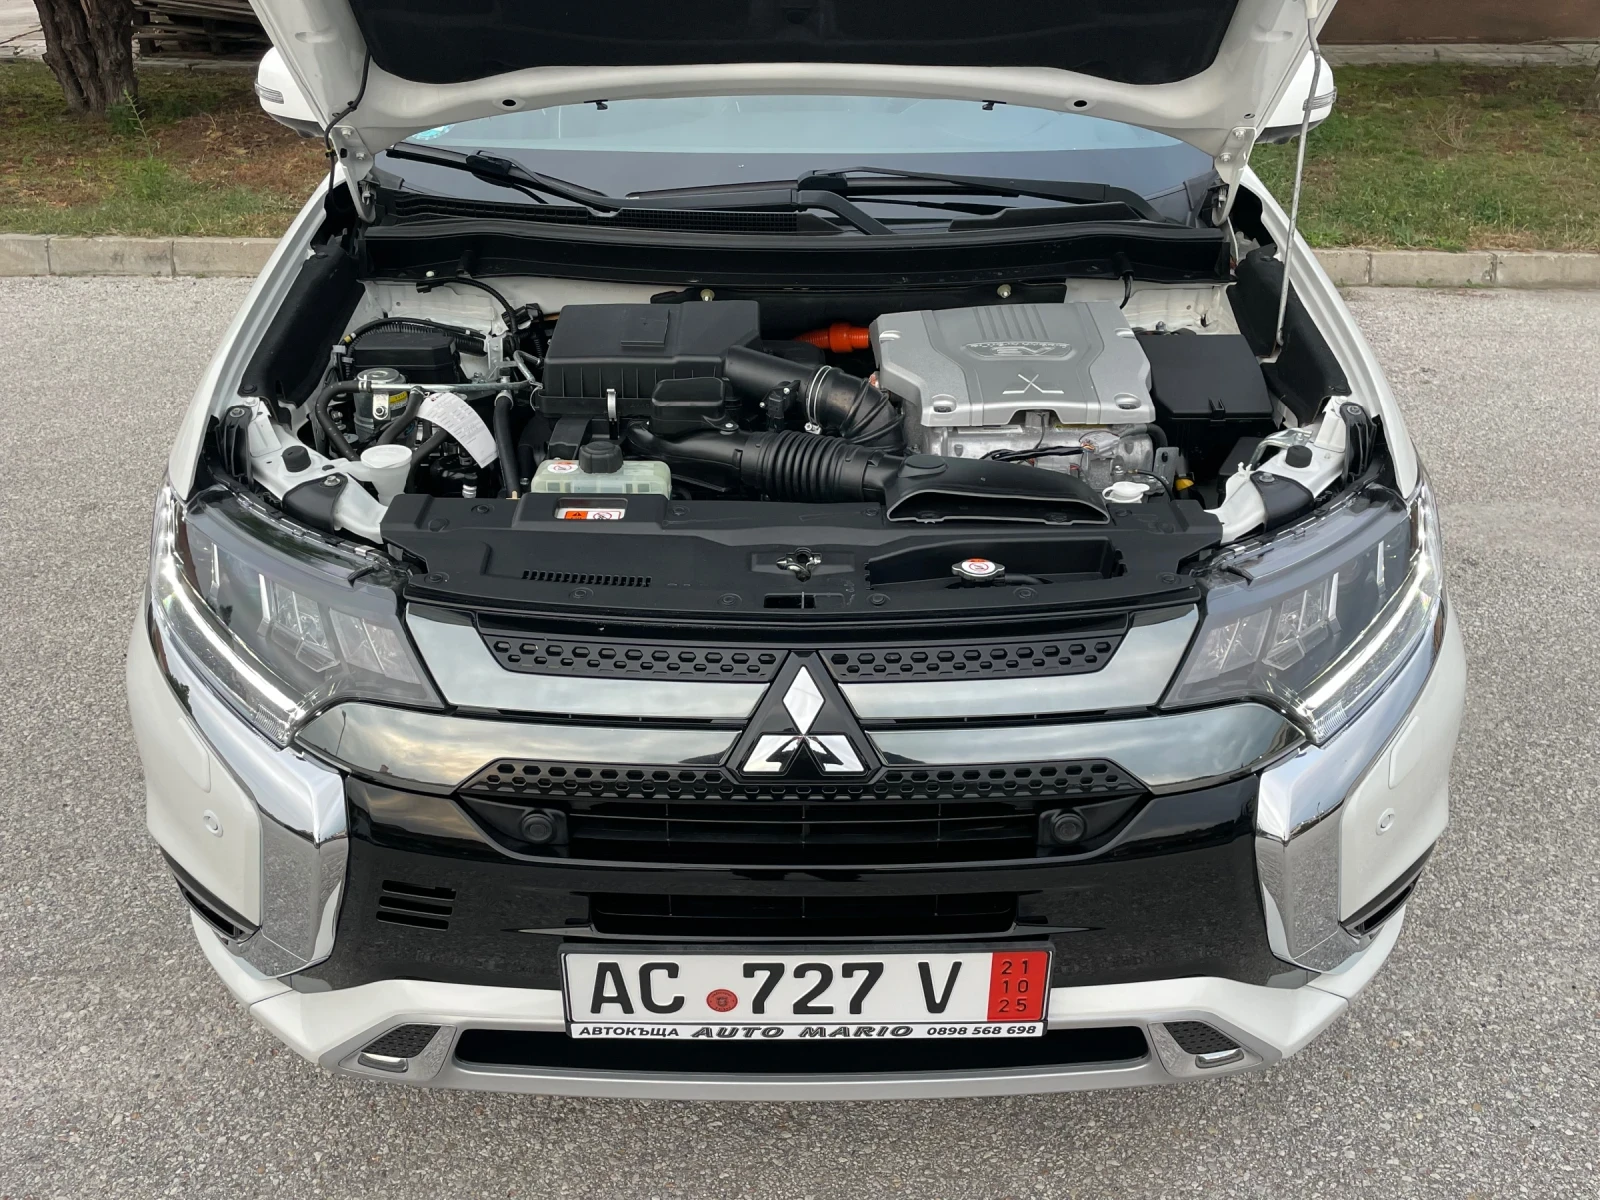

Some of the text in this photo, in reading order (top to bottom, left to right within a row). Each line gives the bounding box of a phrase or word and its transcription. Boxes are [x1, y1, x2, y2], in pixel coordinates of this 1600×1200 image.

[1001, 960, 1029, 975] 21
[590, 961, 963, 1015] AC 727 V
[1002, 979, 1029, 994] 10
[998, 999, 1027, 1013] 25
[578, 1026, 679, 1037] АВТОКЪЩА
[690, 1025, 914, 1038] AUTO MARIO
[926, 1025, 1037, 1036] 0898 568 698
